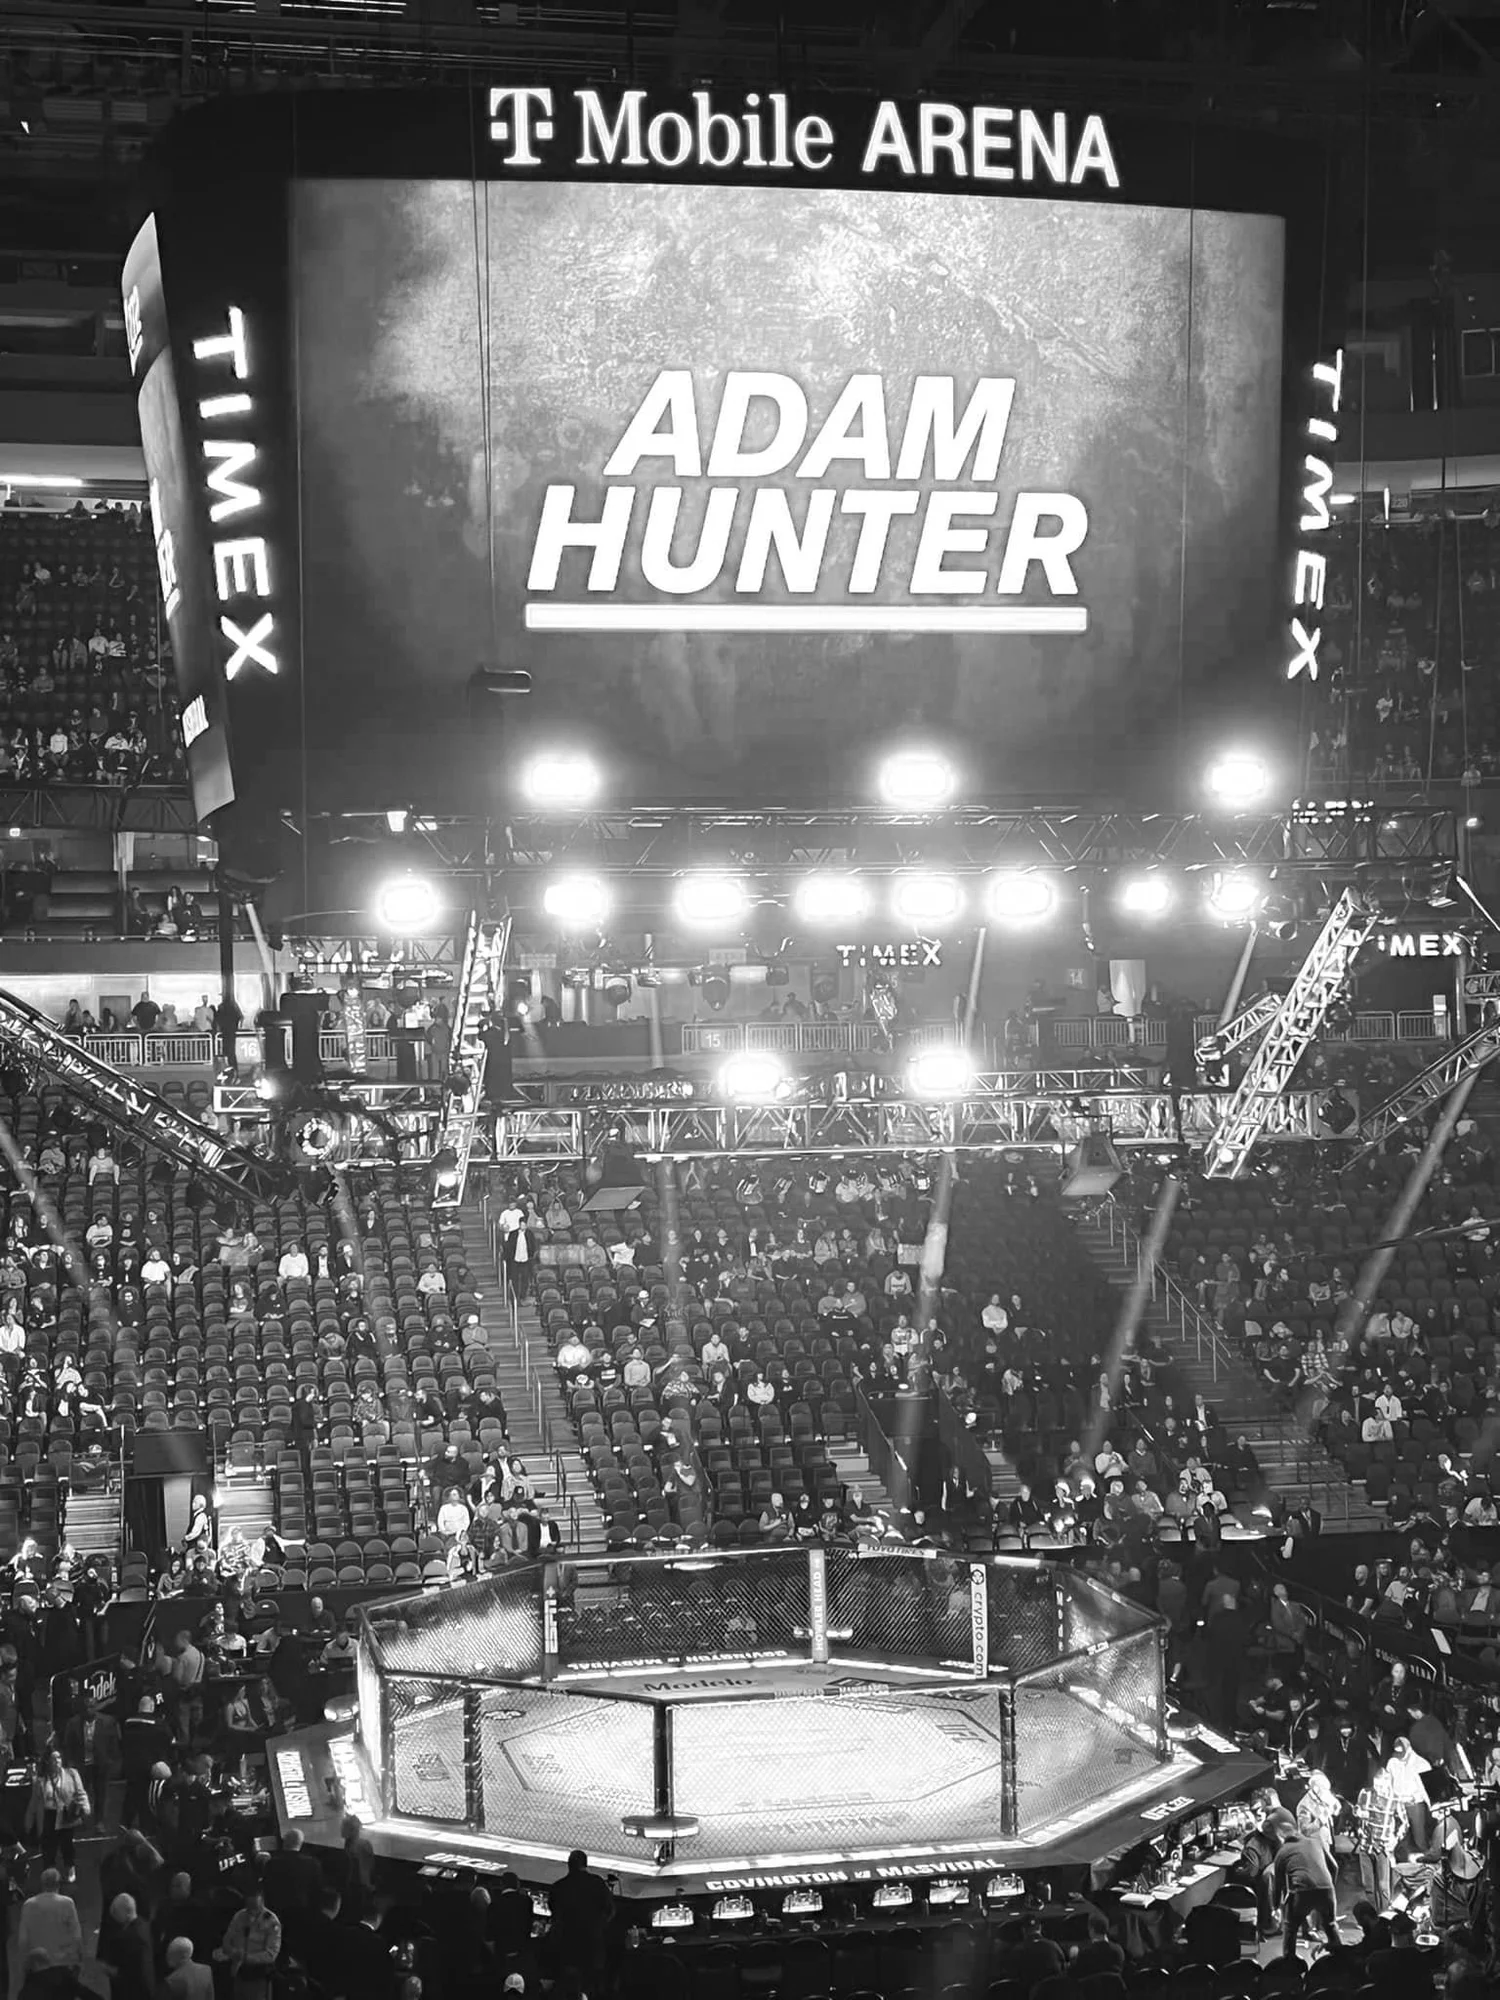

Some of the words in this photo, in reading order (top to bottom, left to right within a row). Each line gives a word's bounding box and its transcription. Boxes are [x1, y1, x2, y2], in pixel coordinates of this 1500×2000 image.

[573, 89, 834, 170] Mobile
[862, 100, 1120, 188] ARENA
[603, 368, 1017, 482] ADAM
[193, 304, 280, 681] TIMEX
[1286, 348, 1345, 682] TIMEX
[527, 484, 1089, 596] HUNTER
[1366, 933, 1463, 957] IMEX
[240, 1042, 258, 1058] 16
[705, 1033, 721, 1048] 15
[643, 1677, 752, 1692] Modelo
[218, 1853, 246, 1872] UFC
[705, 1870, 848, 1891] COVINGTON
[876, 1858, 1006, 1878] MASVIDAL
